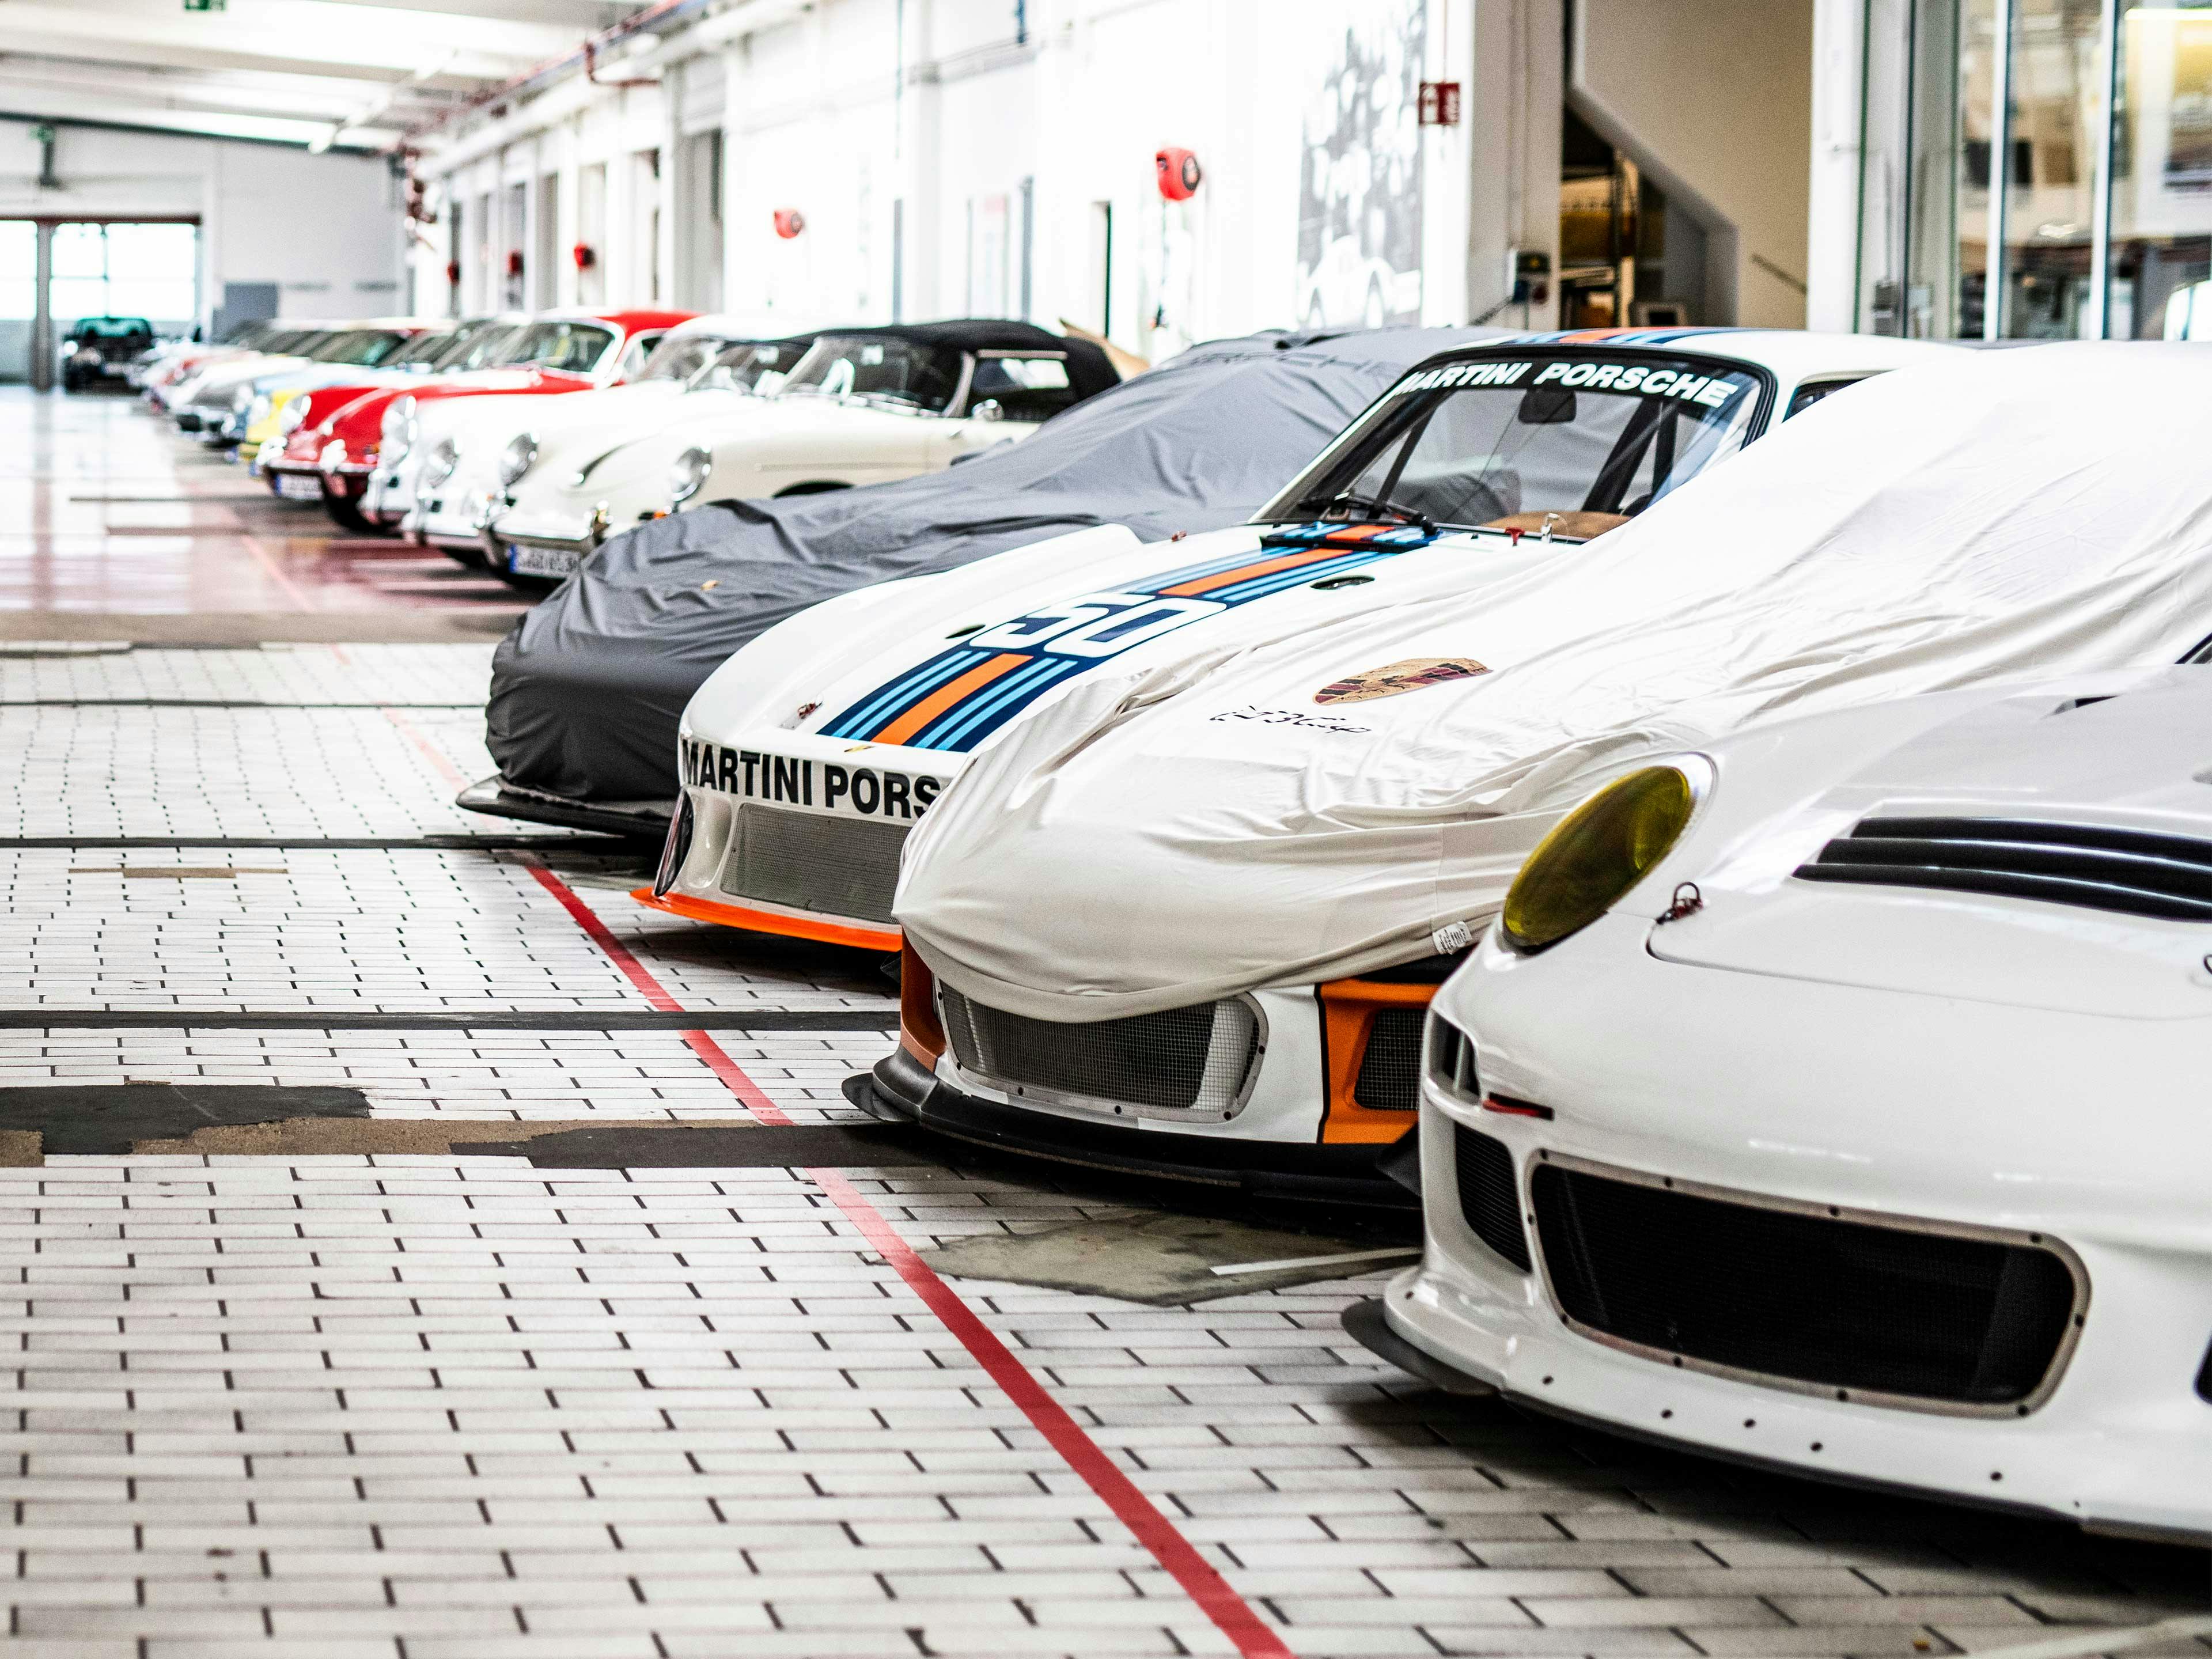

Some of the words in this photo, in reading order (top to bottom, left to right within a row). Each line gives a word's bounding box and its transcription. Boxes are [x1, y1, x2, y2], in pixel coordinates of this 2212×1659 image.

[1392, 362, 1533, 397] MARTINI
[1532, 362, 1738, 408] PORSCHE
[969, 592, 1228, 658] 30
[682, 738, 813, 806] MARTINI
[824, 763, 948, 819] PORS
